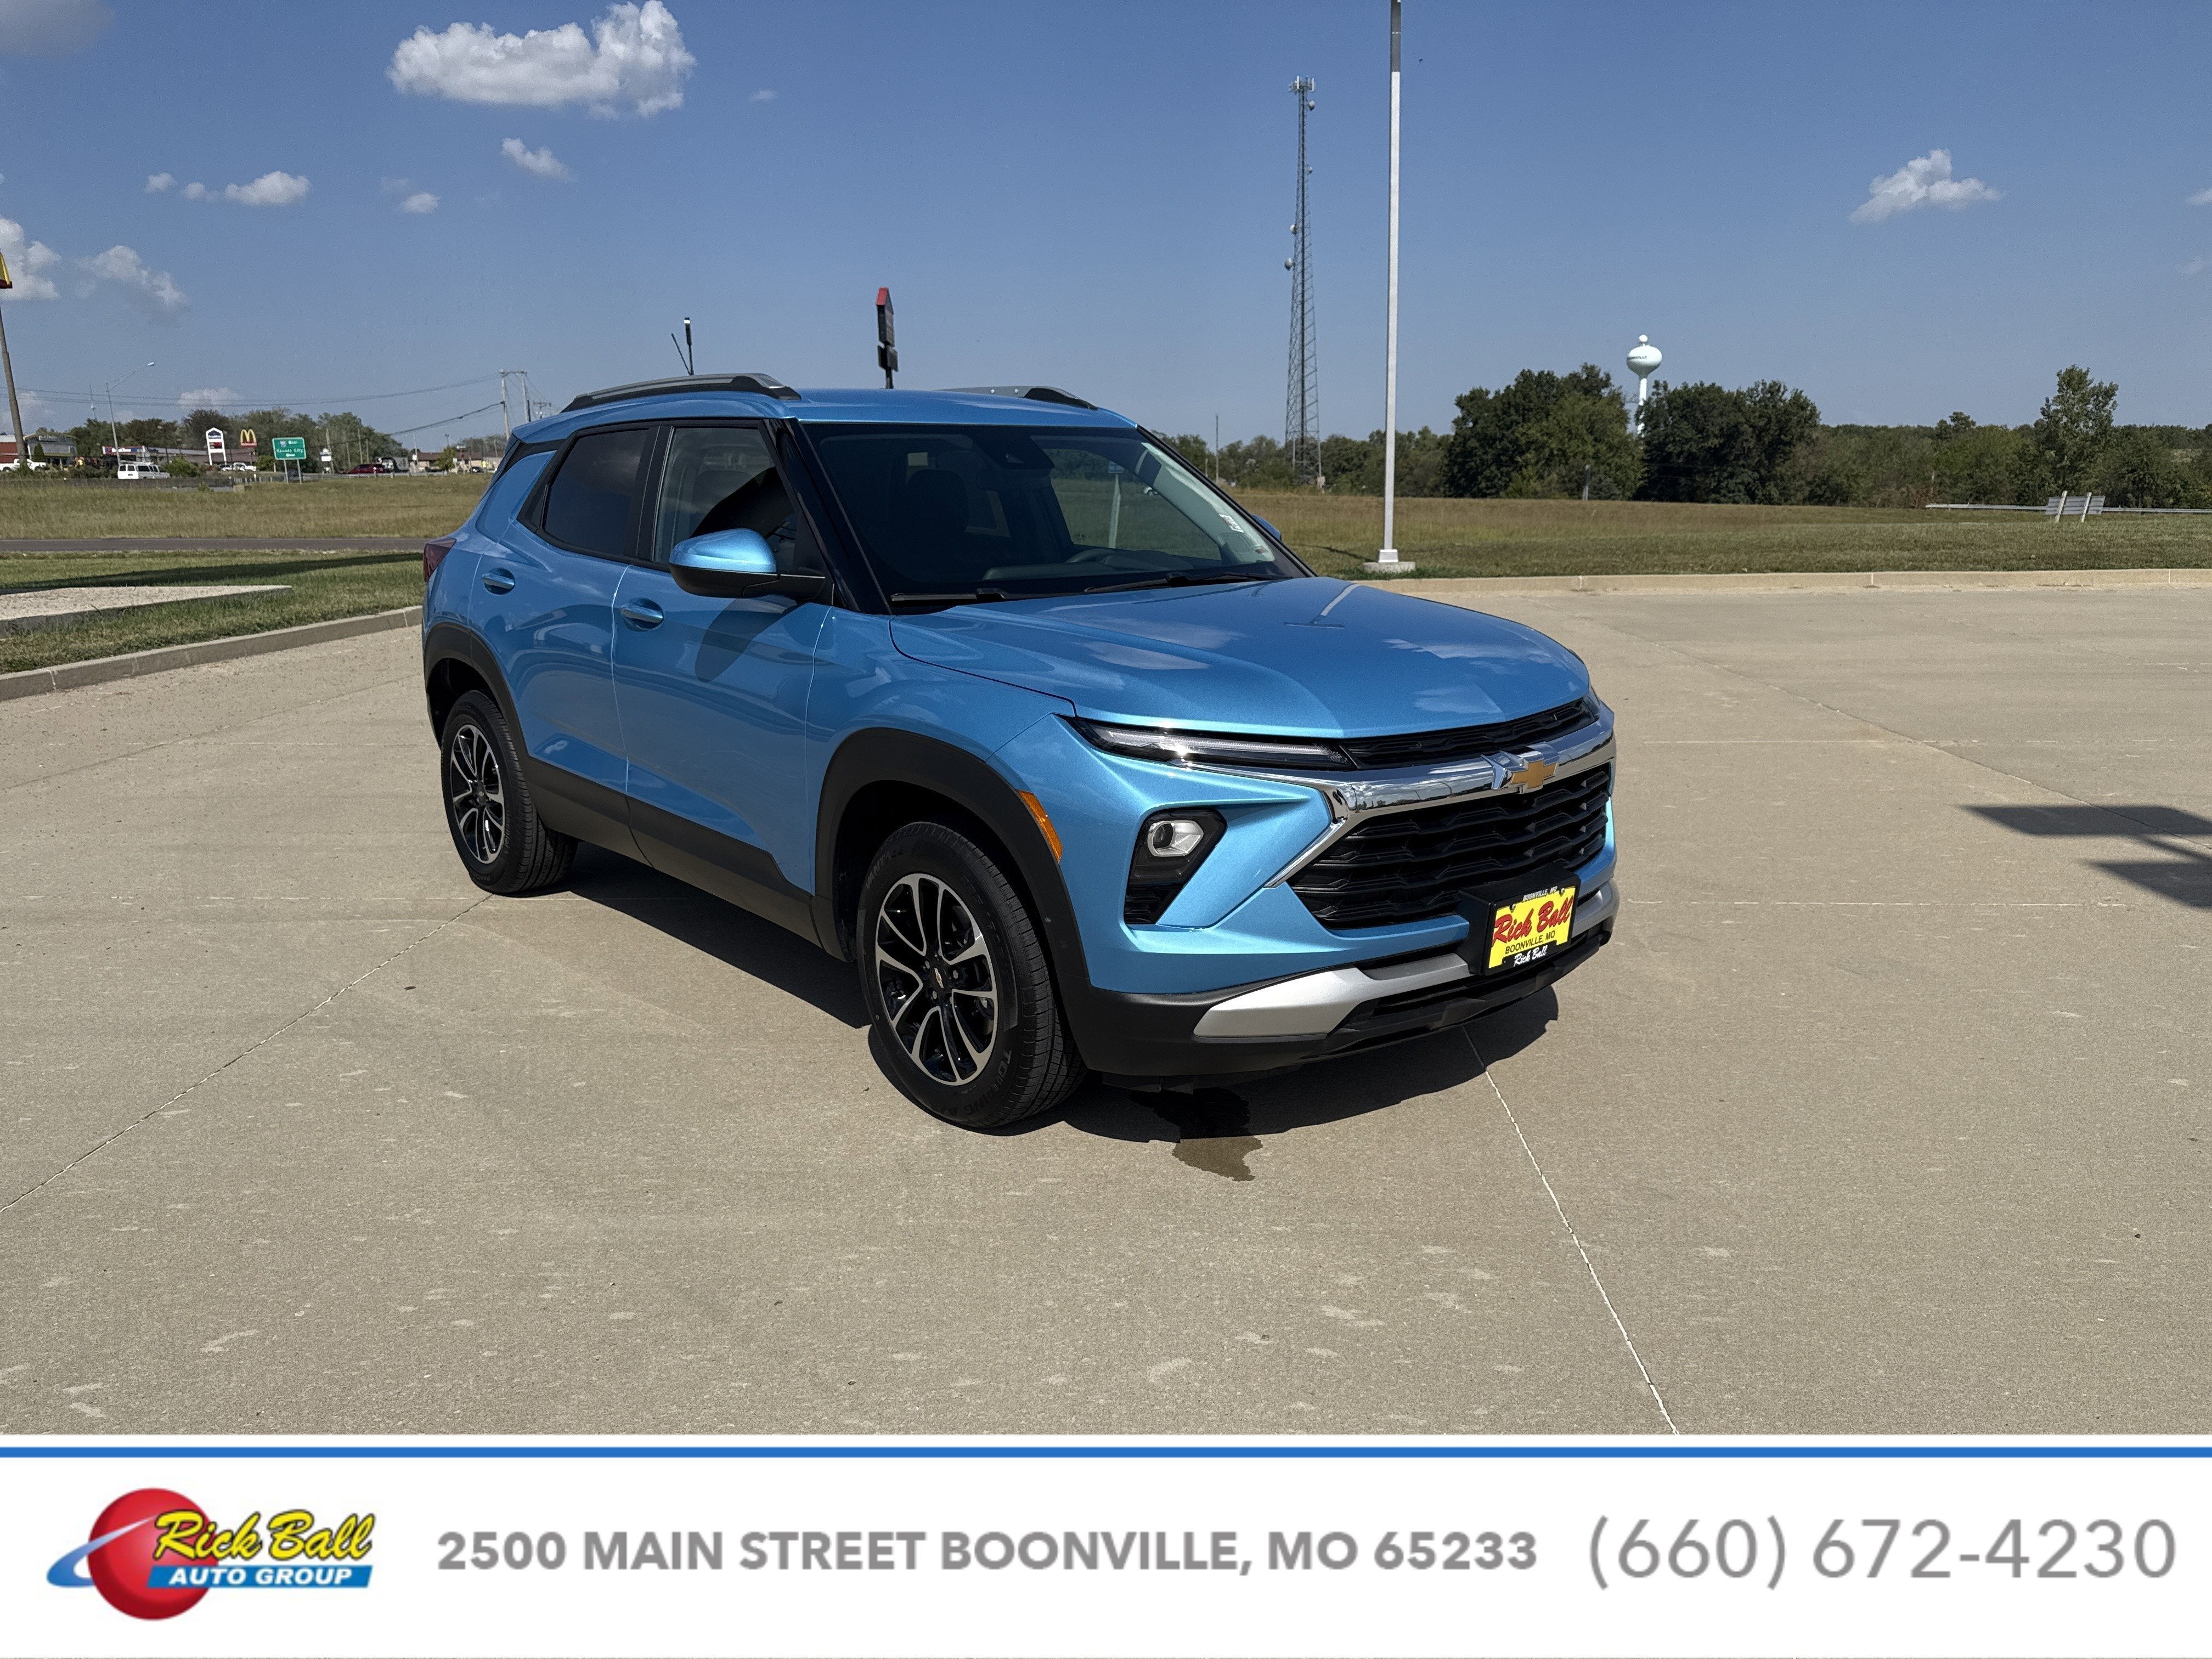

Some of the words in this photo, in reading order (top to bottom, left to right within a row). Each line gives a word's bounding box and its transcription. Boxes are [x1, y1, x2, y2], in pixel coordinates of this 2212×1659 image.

[1522, 888, 1549, 902] BOONVILLE,
[1550, 885, 1558, 894] MO
[1491, 908, 1534, 949] Rick
[1537, 895, 1574, 933] Ball
[1505, 935, 1544, 955] BOONVILLE,
[1545, 930, 1556, 940] MO
[1513, 952, 1531, 967] Rick
[1532, 945, 1548, 961] Ball
